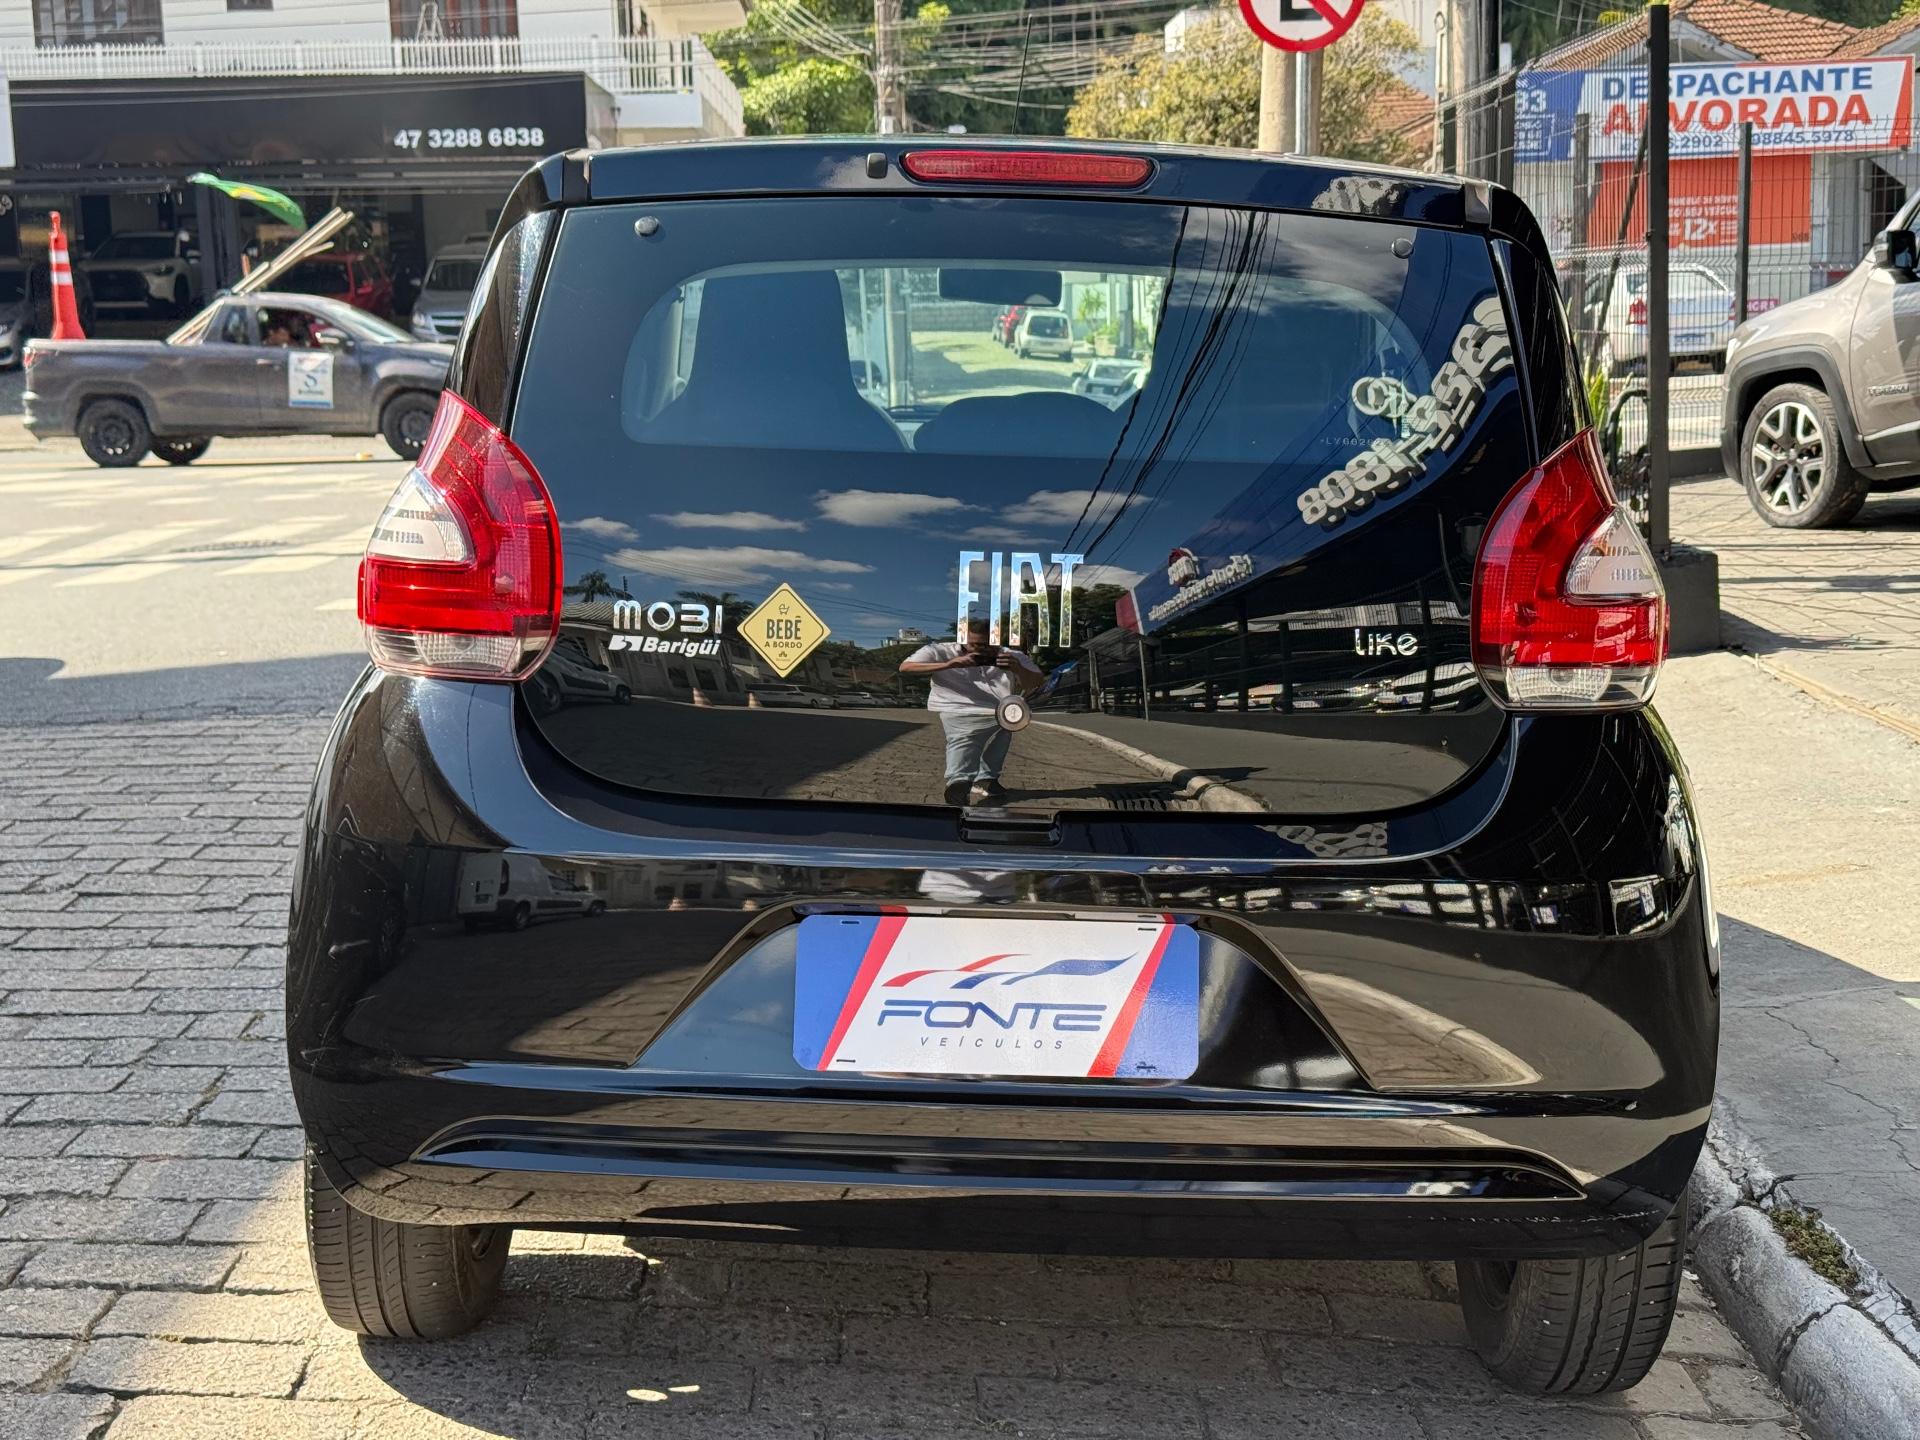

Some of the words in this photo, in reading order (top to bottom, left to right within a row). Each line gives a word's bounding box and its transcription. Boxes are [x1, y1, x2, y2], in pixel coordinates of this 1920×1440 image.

[1601, 66, 1873, 100] DEPACHANTE
[394, 128, 422, 149] 47
[428, 127, 482, 148] 3288
[488, 126, 545, 147] 6838
[957, 551, 1084, 647] FIAT
[766, 615, 802, 640] BEBÊ
[642, 637, 721, 657] Barigüi
[773, 641, 803, 649] BORDO
[877, 999, 1108, 1031] FONTE
[920, 1035, 1063, 1049] VEÍCULOS
